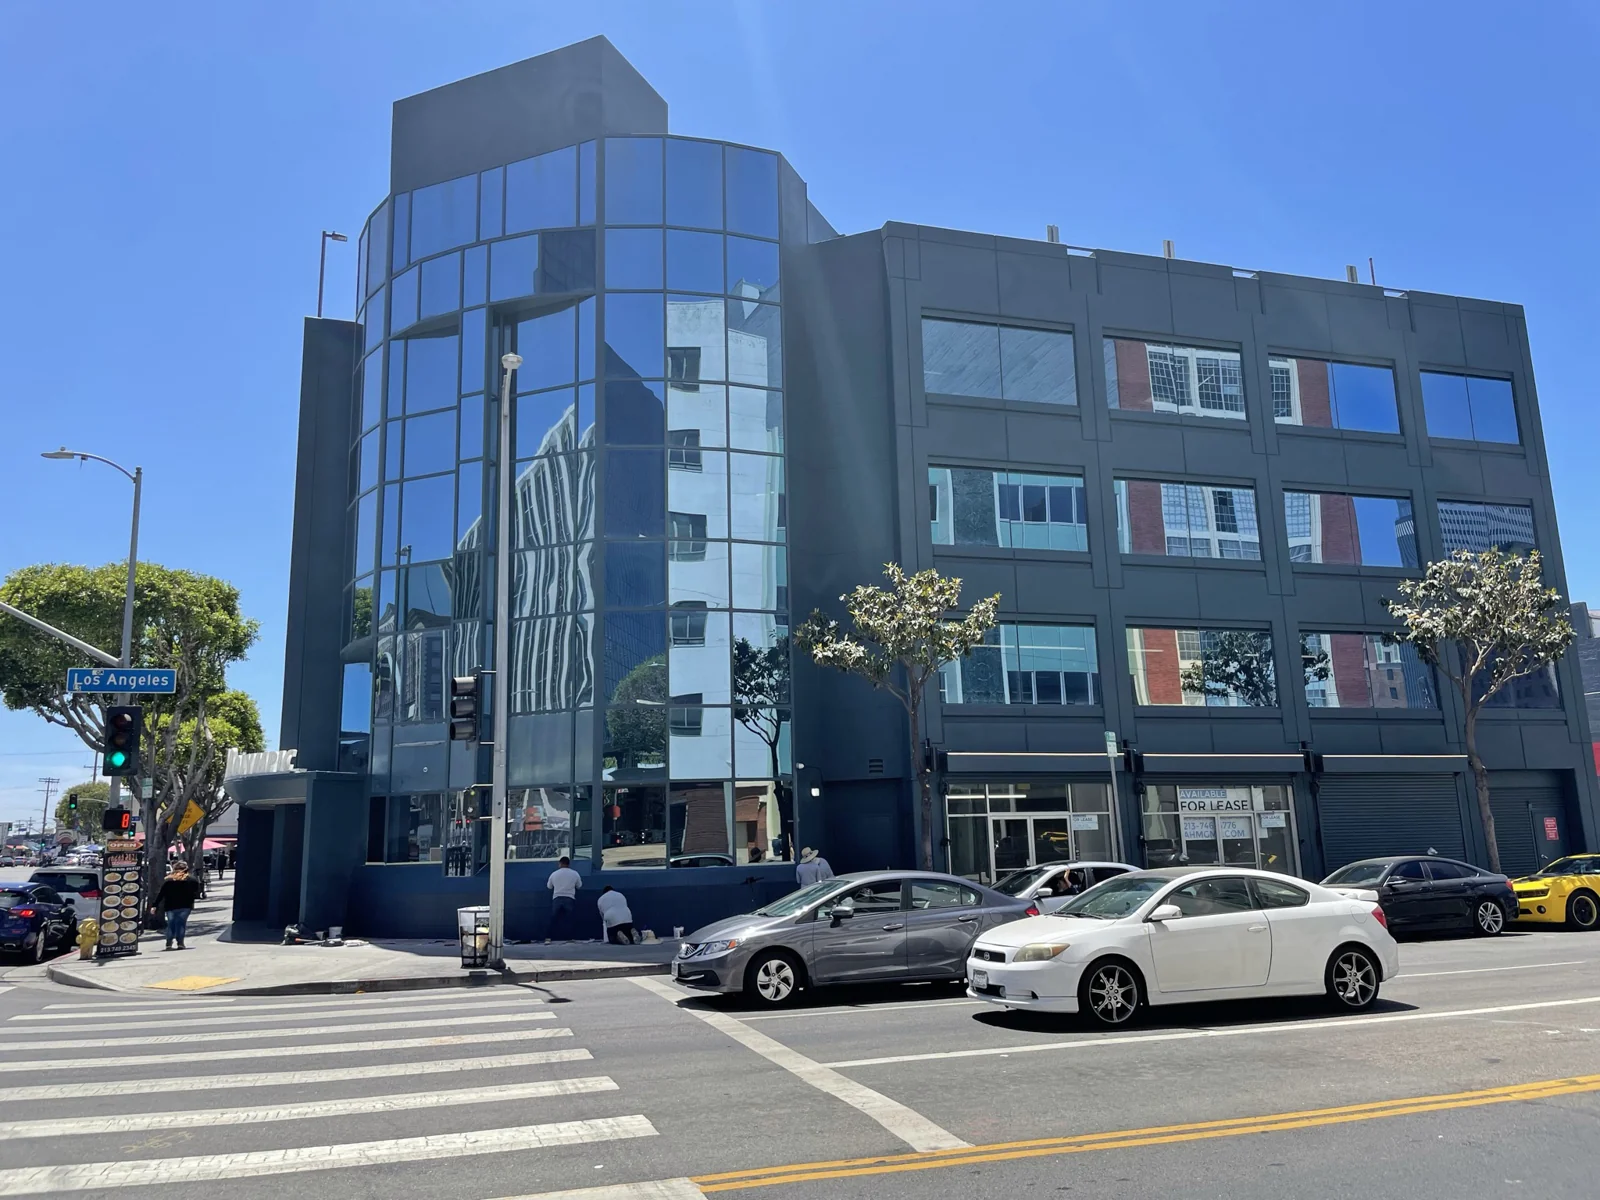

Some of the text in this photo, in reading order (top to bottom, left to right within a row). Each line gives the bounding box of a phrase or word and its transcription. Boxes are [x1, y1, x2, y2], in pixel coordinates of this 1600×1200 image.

[74, 673, 169, 689] Los Angeles
[1180, 790, 1226, 798] AVAILABLE
[1180, 800, 1249, 811] FOR LEASE
[121, 813, 130, 828] 8
